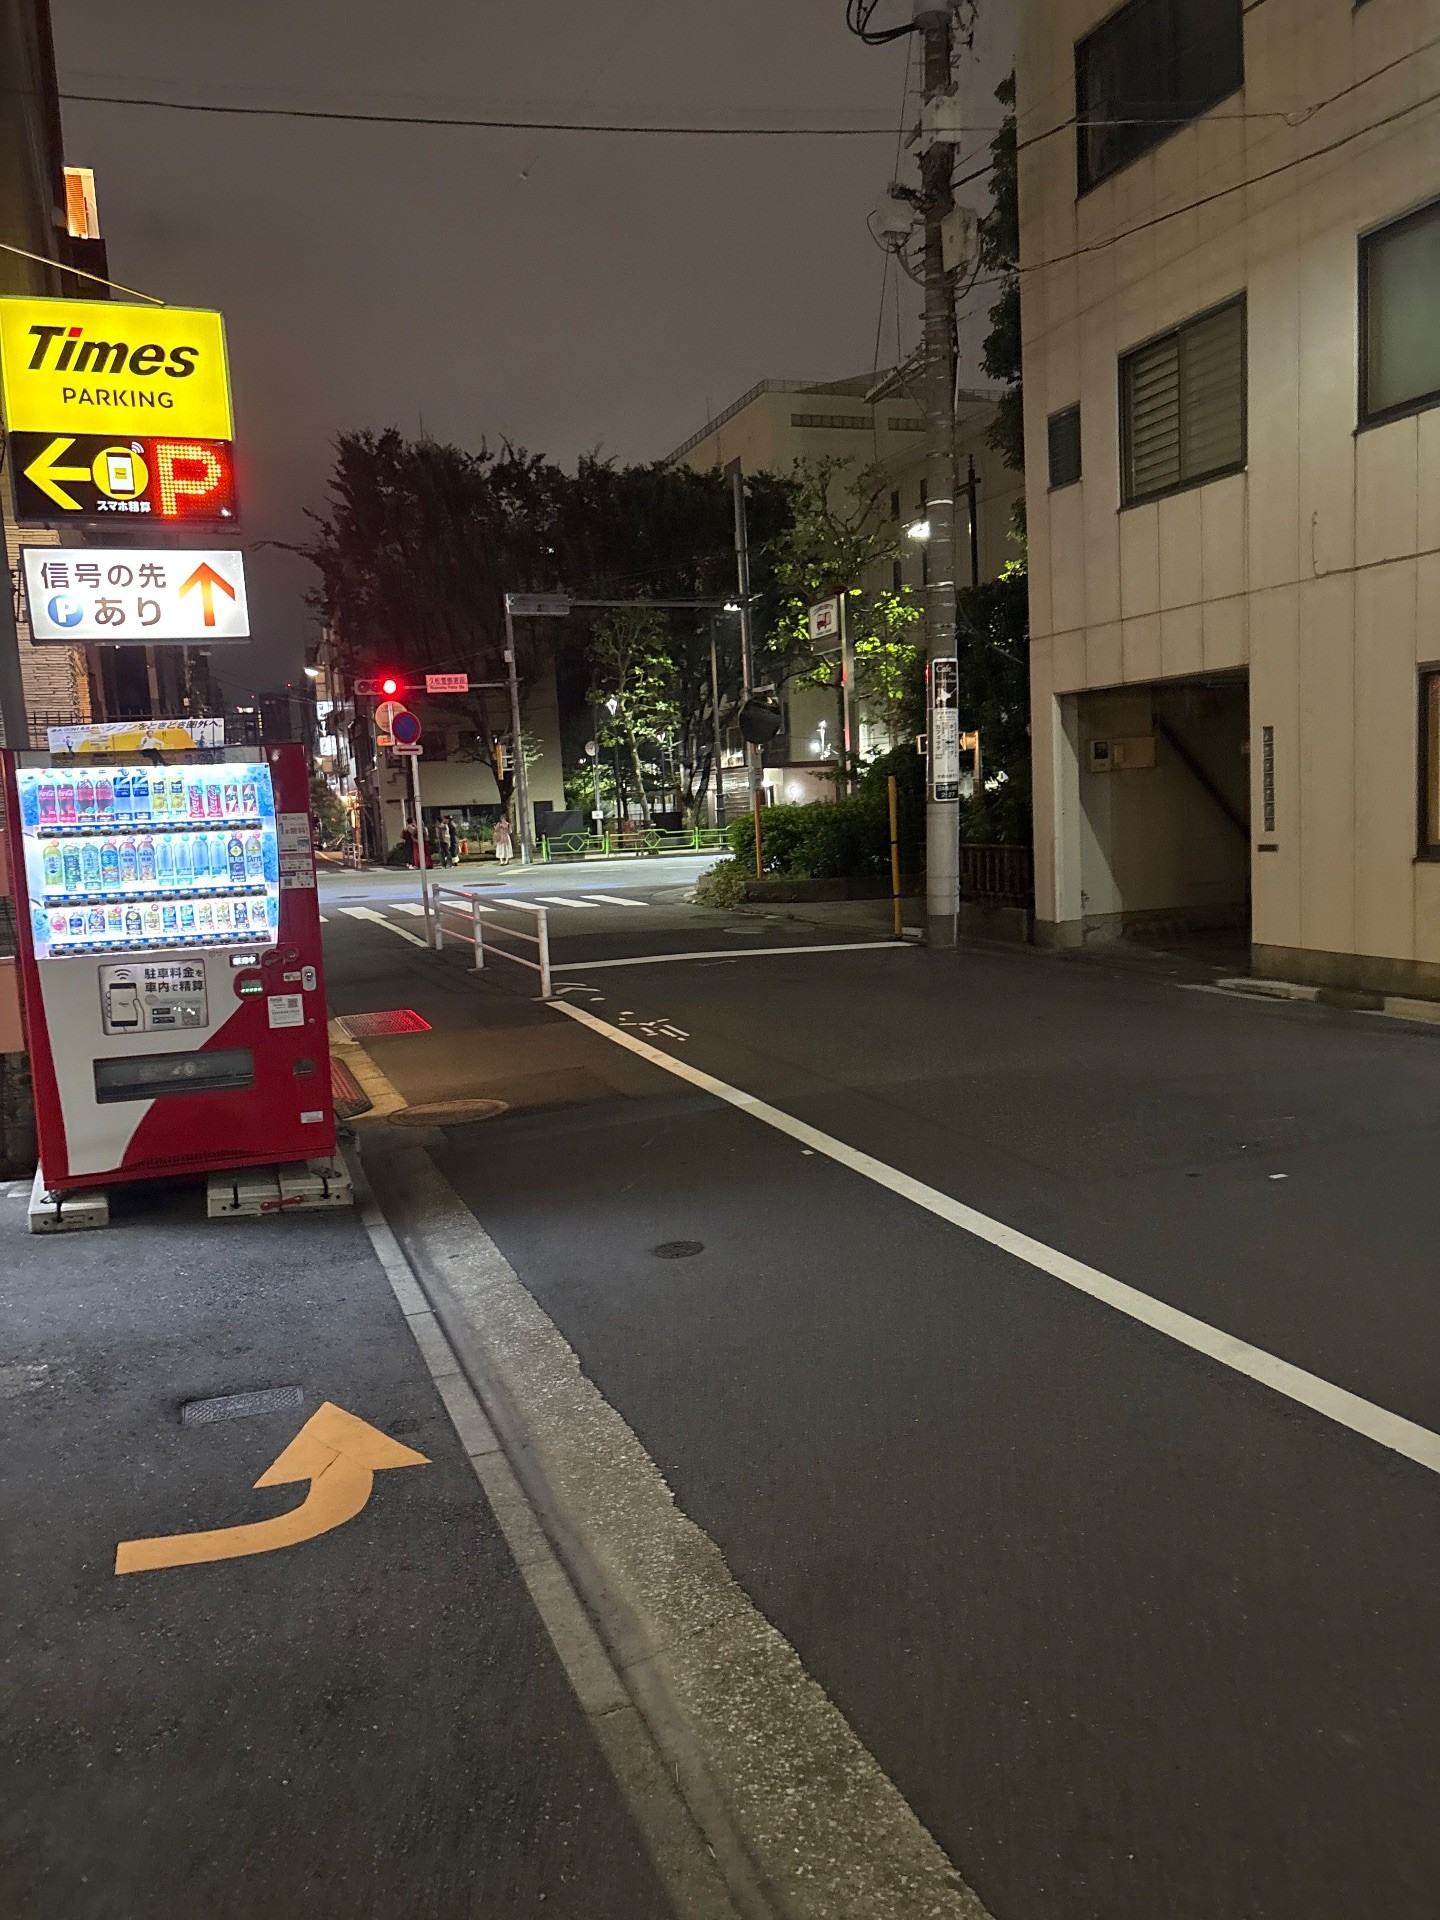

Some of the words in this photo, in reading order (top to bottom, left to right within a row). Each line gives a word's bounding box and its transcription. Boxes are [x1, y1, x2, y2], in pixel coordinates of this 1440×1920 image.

[28, 325, 199, 378] Times
[63, 387, 173, 409] PARKING
[156, 444, 222, 515] P
[97, 500, 151, 513] スマホ精算
[41, 562, 166, 590] 信号の先
[95, 596, 162, 627] あり
[144, 966, 204, 981] 駐車料金を
[144, 980, 204, 993] 車内で精算
